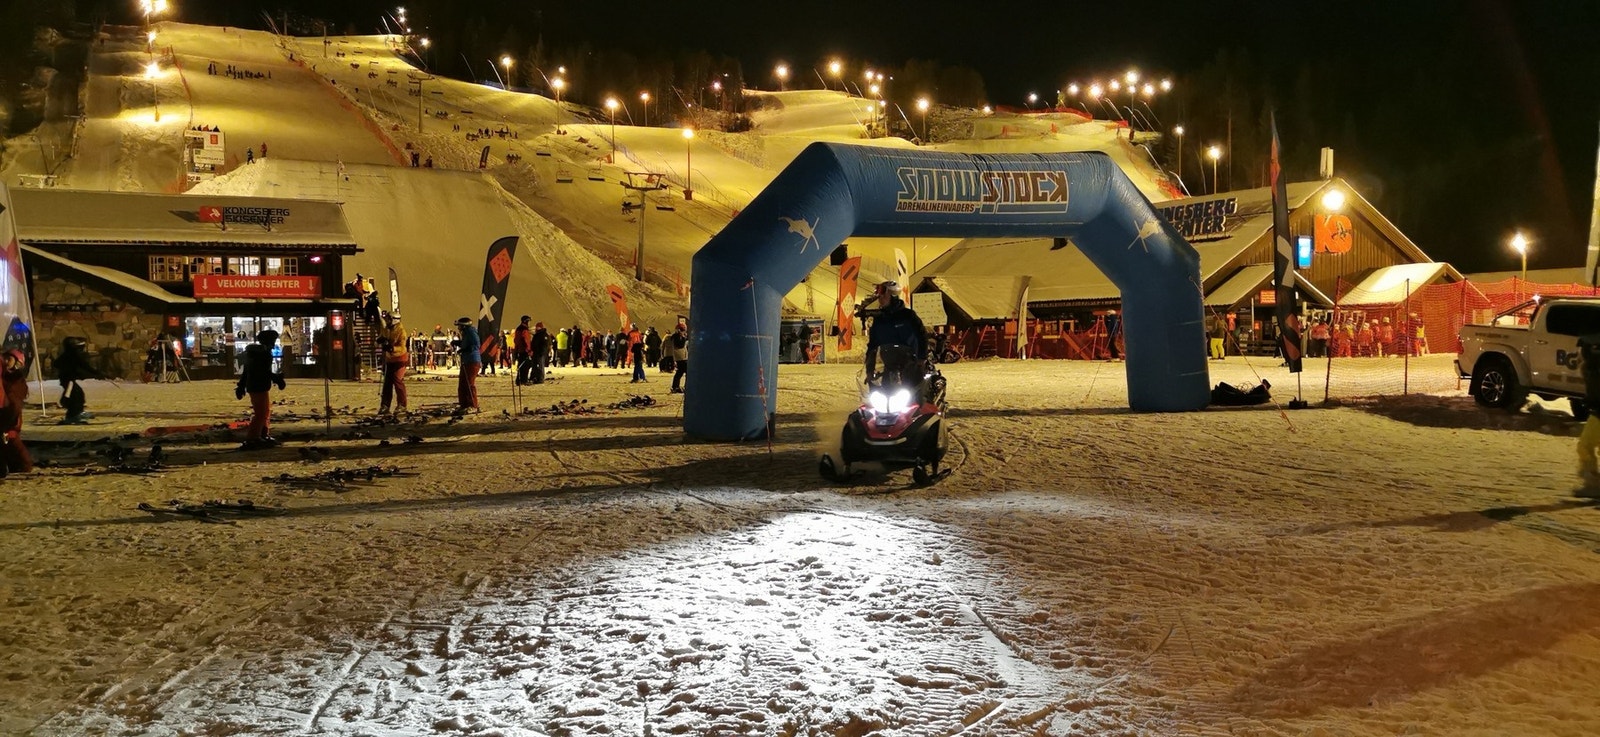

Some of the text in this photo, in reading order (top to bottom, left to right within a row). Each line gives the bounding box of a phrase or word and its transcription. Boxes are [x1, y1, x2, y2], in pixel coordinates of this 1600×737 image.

[224, 206, 290, 216] KONGSBERG
[896, 201, 975, 213] ADRENALINEINVADERS
[1160, 197, 1237, 221] NGSBERG
[224, 215, 284, 224] SKISENTER
[1174, 216, 1226, 236] ENTER
[217, 279, 300, 289] VELKOMSTSENTER
